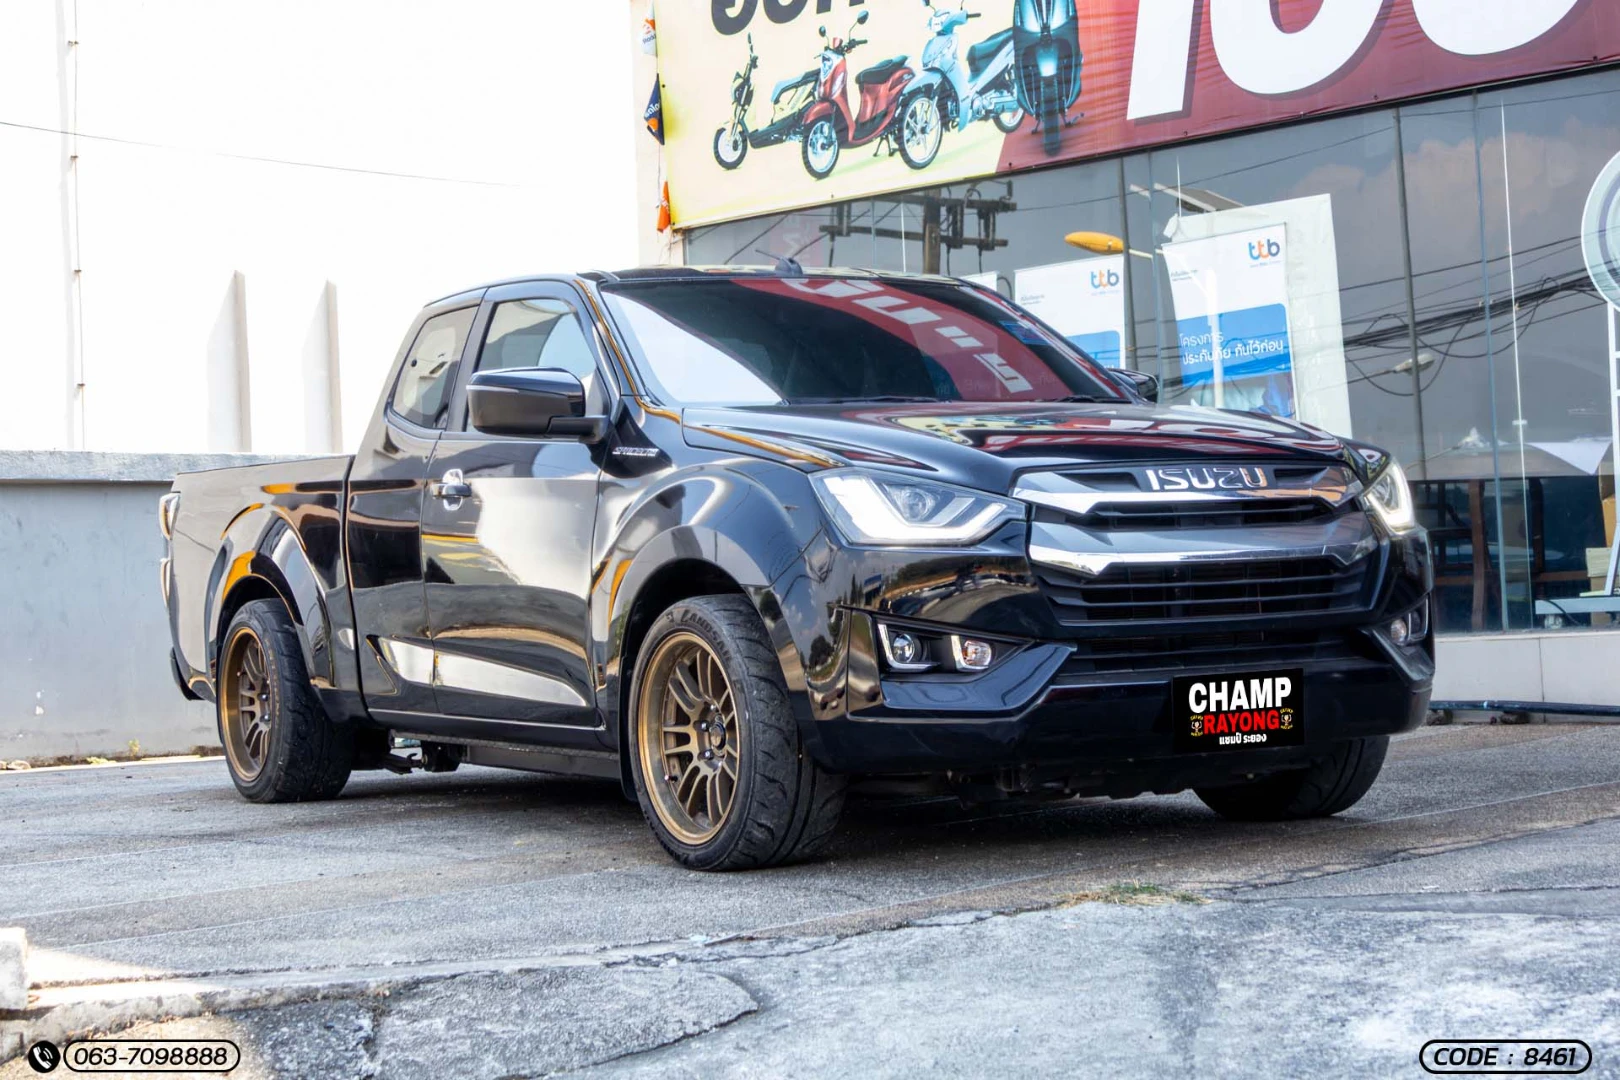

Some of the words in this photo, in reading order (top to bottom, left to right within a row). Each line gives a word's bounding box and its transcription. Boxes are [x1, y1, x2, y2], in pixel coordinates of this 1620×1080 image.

[1248, 239, 1280, 260] ttb
[1091, 269, 1119, 289] ttb
[1145, 467, 1268, 491] ISUZU
